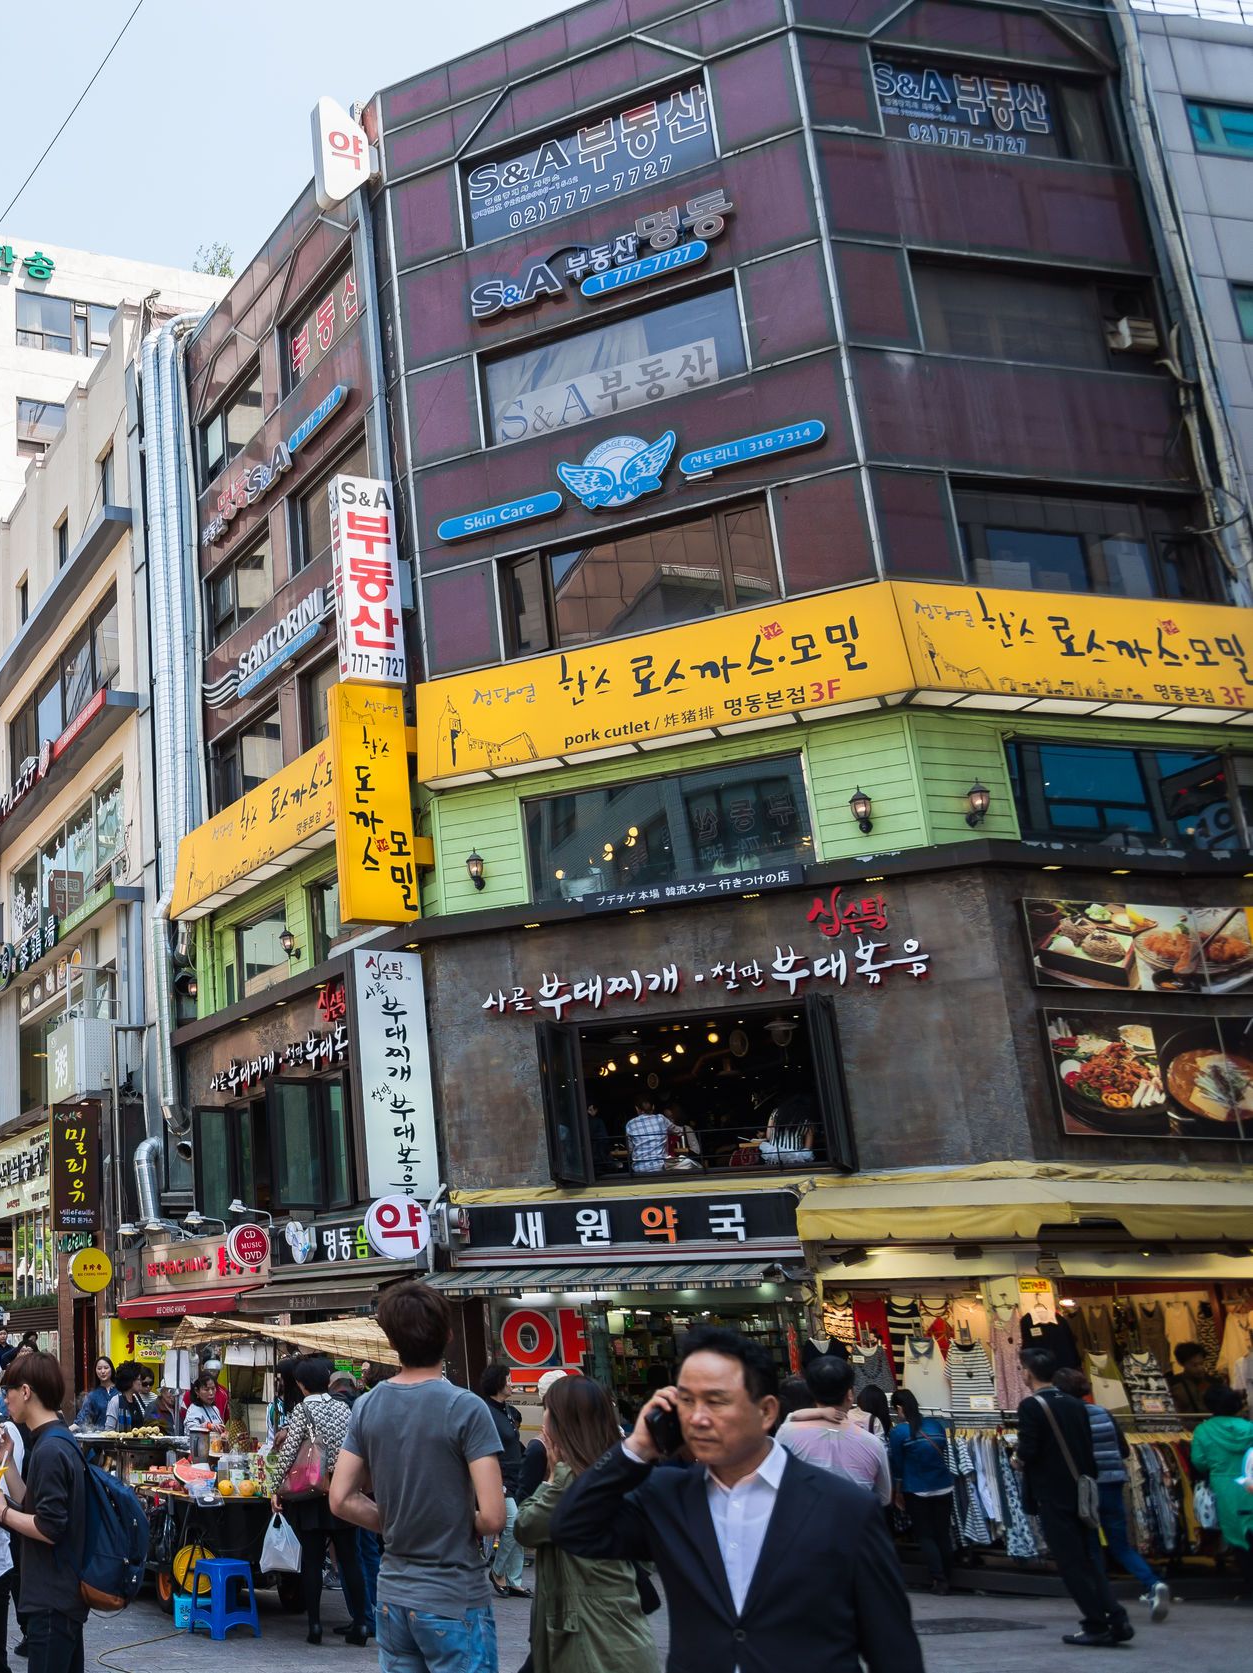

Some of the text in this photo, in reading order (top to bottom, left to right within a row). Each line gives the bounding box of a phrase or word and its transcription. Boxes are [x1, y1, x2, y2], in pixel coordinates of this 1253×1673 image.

[872, 62, 1049, 135] S&A 부동산
[329, 131, 363, 170] 약
[468, 84, 708, 201] S&A 부동산
[908, 123, 1027, 155] 02)777-7727
[509, 154, 673, 229] 02)777-7727
[471, 189, 734, 319] S&A 부동산 명동
[613, 247, 692, 285] 777-7727
[501, 345, 713, 442] S&A 부동산
[247, 441, 292, 505] S&A
[689, 428, 812, 469] 산토리니 318-7314
[341, 481, 392, 511] S&A
[464, 501, 535, 531] Skin Care
[345, 515, 400, 651] 부동산
[239, 587, 324, 682] SANTORINI
[351, 652, 405, 680] 777-7727
[1153, 682, 1246, 706] 명동본점 3F
[564, 729, 602, 749] pork
[603, 718, 651, 743] cutlet
[723, 685, 807, 718] 명동본점
[809, 678, 842, 705] 3F
[349, 765, 384, 871] 돈까스
[389, 830, 419, 912] 모밀
[482, 935, 932, 1022] 사골 부대찌개 철판 부대볶음
[380, 996, 412, 1083] 부대찌개
[389, 1093, 423, 1196] 부대볶음
[241, 1241, 263, 1250] MUSIC
[244, 1230, 256, 1239] CD
[375, 1202, 424, 1252] 약
[512, 1202, 747, 1250] 새원약국
[160, 1257, 183, 1276] CHENG
[244, 1250, 263, 1261] DVD
